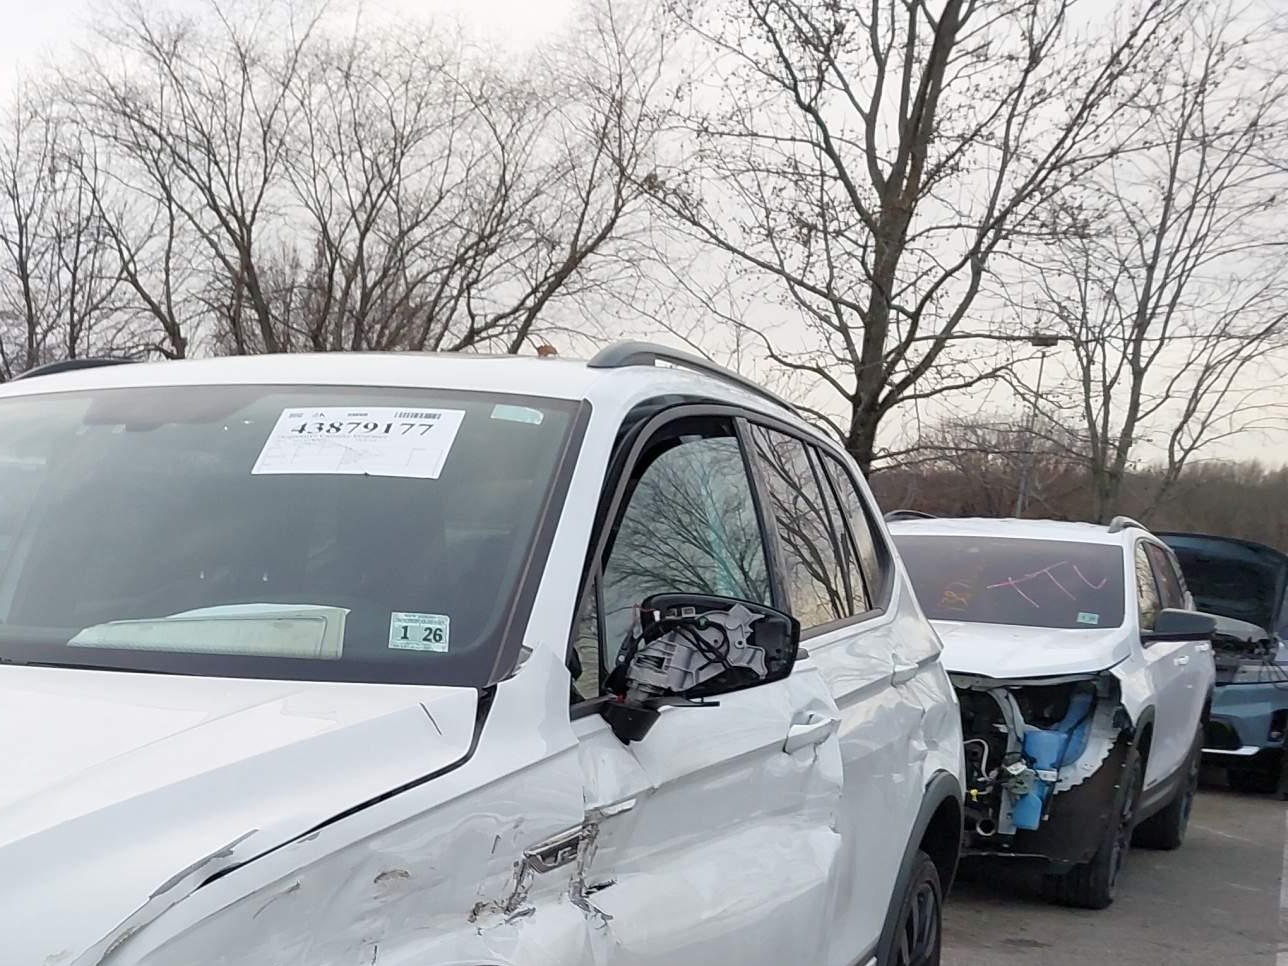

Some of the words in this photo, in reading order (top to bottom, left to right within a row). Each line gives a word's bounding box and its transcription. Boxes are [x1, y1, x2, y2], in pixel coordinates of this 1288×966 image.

[290, 421, 435, 437] 43879177
[400, 625, 410, 640] 1
[422, 626, 444, 643] 26
